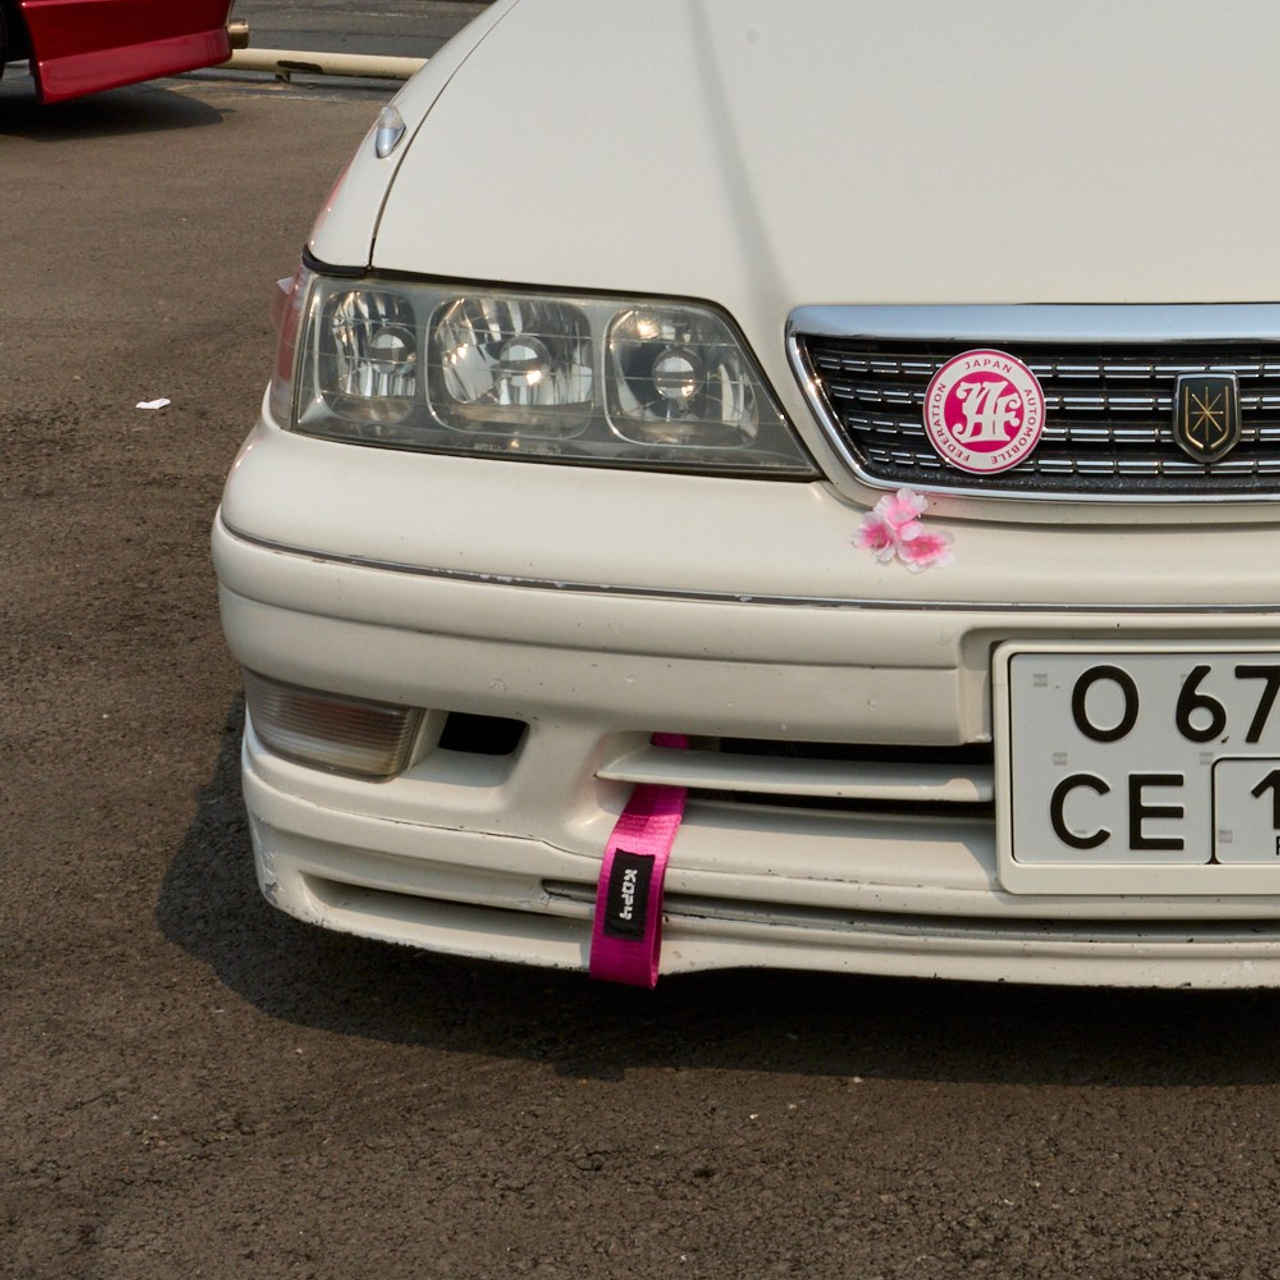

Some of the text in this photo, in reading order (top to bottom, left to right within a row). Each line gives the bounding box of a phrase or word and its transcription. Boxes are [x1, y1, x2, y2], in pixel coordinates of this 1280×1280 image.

[964, 358, 1013, 374] JAPAN
[931, 383, 971, 463] FEDERATION
[990, 388, 1037, 465] AUTOMOBILE
